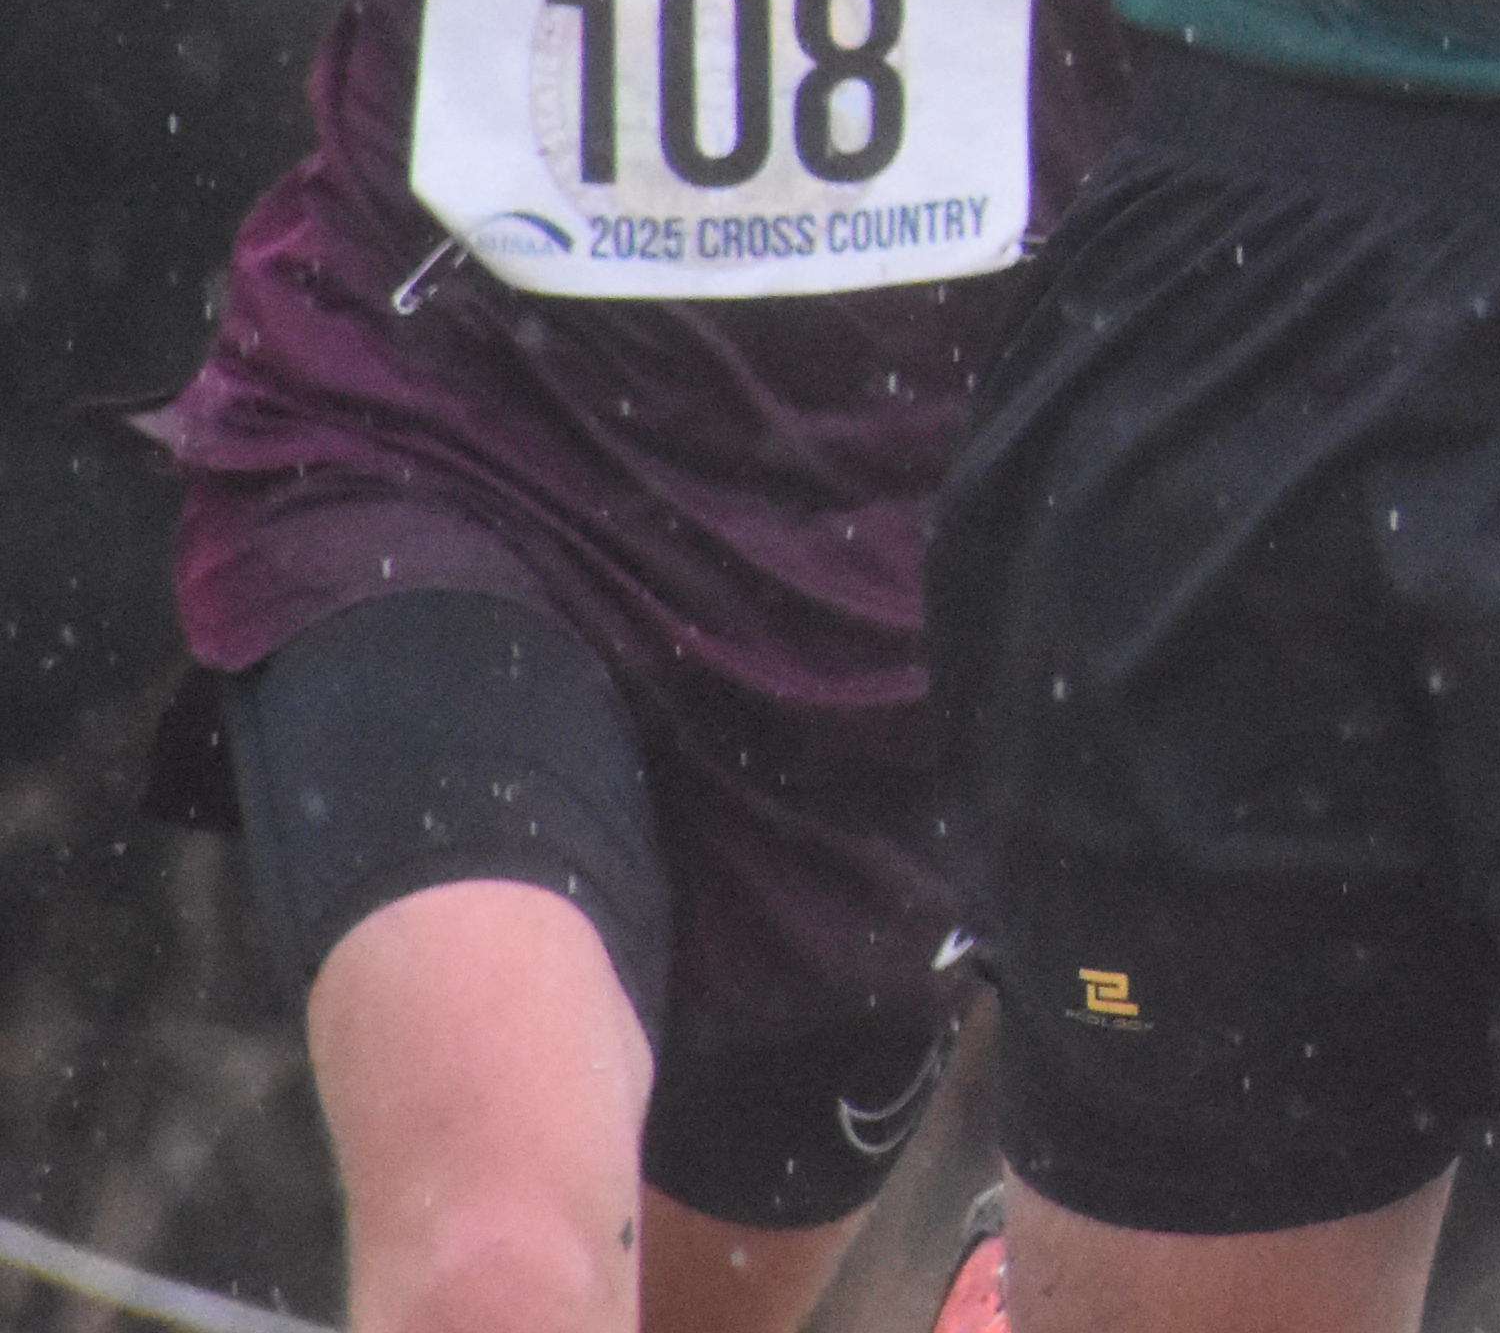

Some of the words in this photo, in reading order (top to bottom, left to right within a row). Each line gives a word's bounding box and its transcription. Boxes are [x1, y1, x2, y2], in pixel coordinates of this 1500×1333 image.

[589, 215, 685, 261] 2025
[699, 213, 816, 261] CROSS
[827, 195, 990, 254] COUNTRY
